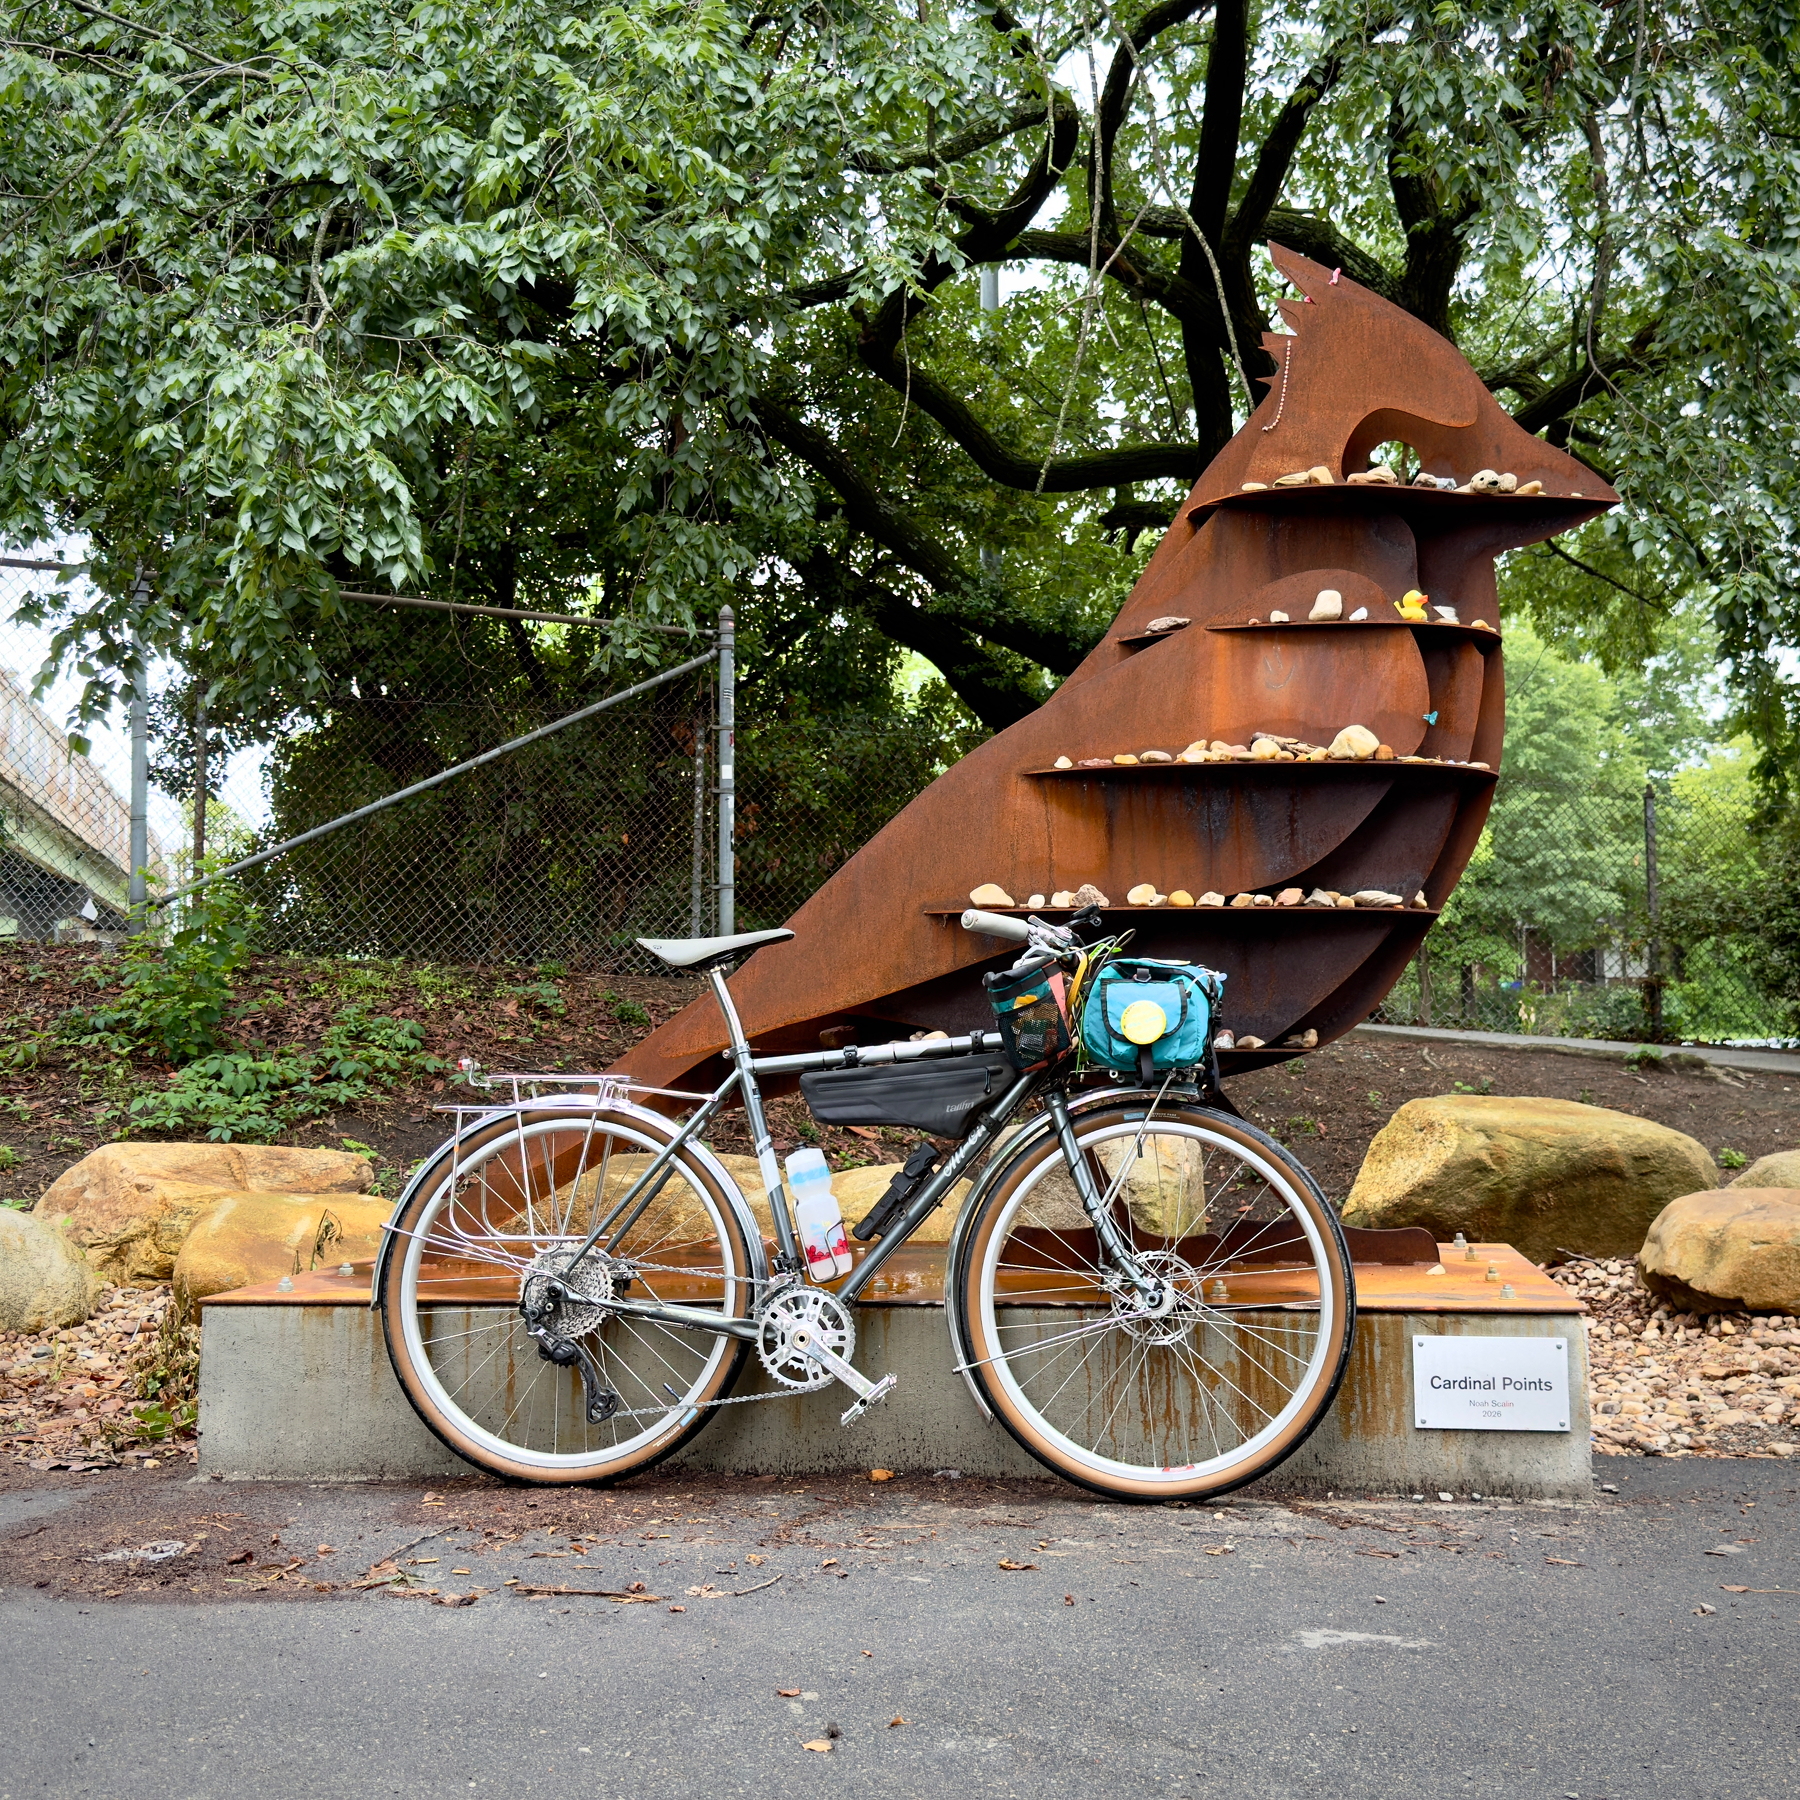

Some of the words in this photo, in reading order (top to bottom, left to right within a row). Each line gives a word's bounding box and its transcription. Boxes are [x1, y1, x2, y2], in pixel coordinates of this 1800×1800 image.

[1430, 1375, 1496, 1390] Cardinal
[1502, 1376, 1553, 1391] Points
[1469, 1399, 1489, 1408] Noah
[1491, 1399, 1514, 1408] Scalin
[1482, 1410, 1502, 1418] 2026
